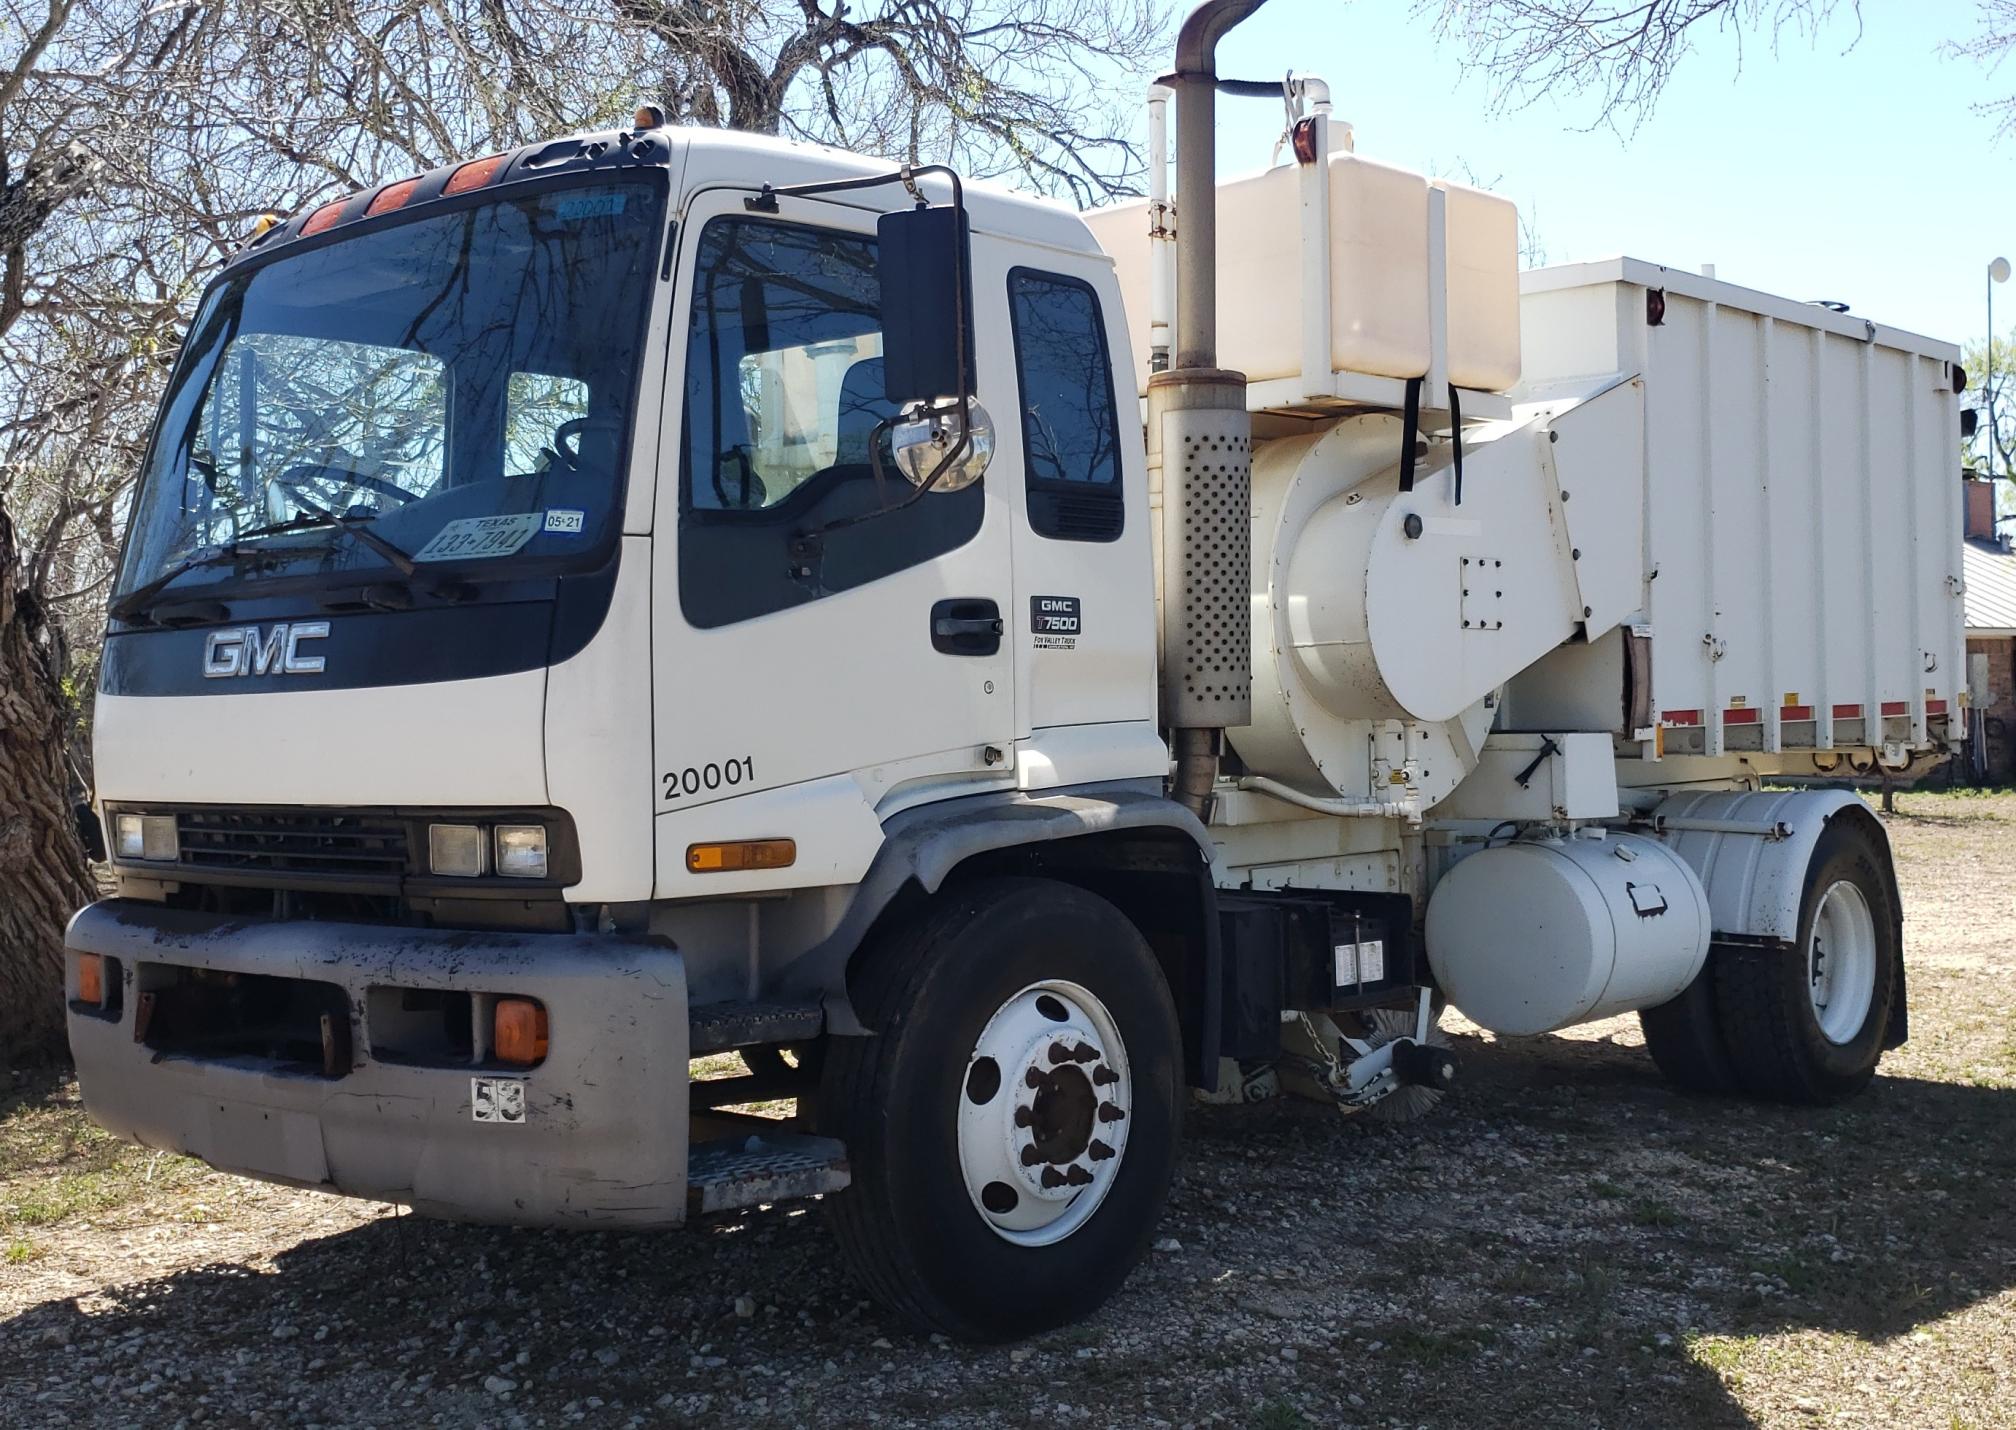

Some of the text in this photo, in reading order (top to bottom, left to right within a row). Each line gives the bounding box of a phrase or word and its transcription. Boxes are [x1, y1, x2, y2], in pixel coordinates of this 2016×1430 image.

[474, 517, 518, 528] TEXAS
[1041, 600, 1073, 612] GMC
[203, 621, 331, 678] GMC
[662, 755, 754, 800] 20001
